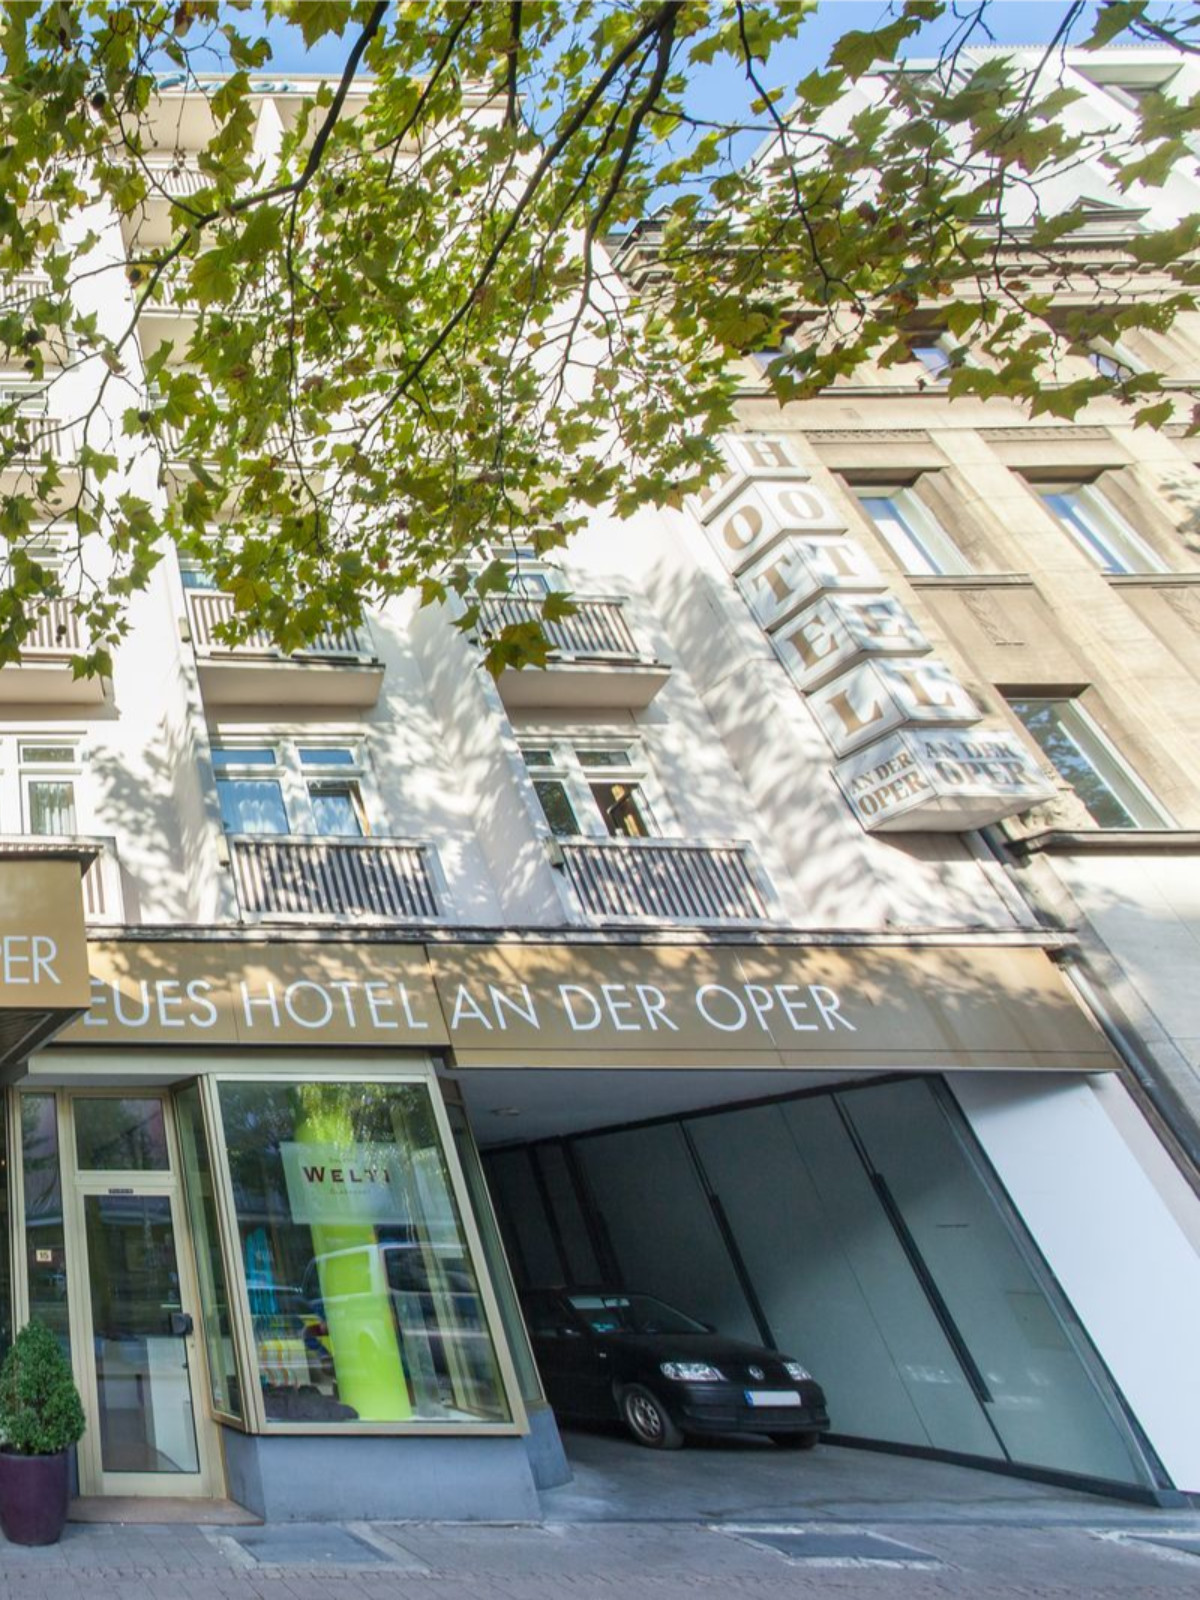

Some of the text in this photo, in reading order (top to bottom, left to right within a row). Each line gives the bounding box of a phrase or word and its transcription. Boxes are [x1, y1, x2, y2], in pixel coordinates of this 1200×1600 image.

[742, 440, 955, 709] HOTEL
[924, 741, 959, 758] AN
[851, 751, 914, 794] AN DER
[857, 770, 931, 816] OPER
[934, 760, 1040, 787] OPER
[83, 979, 858, 1032] EUES HOTEL AN DER OPER
